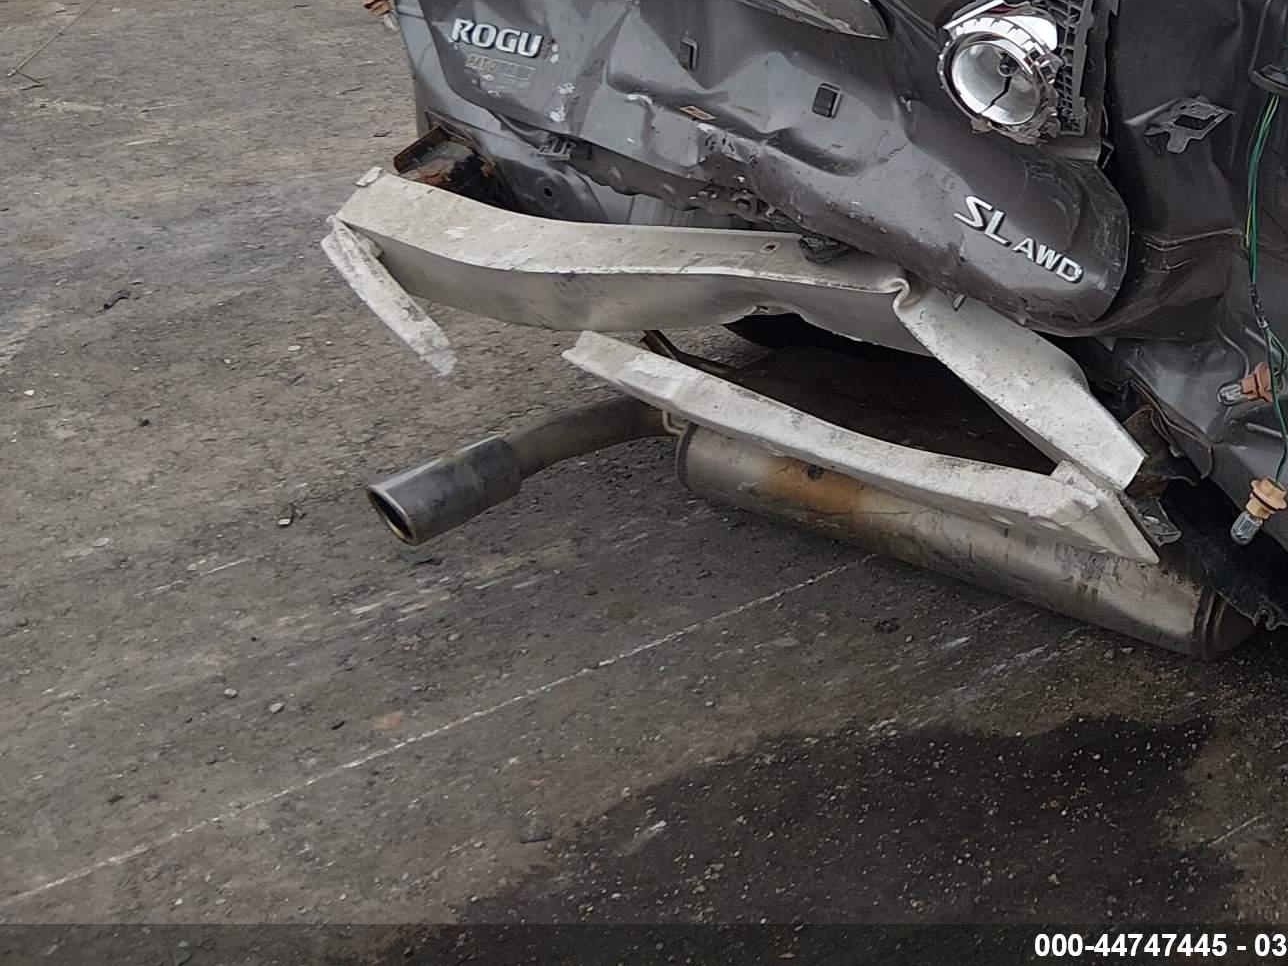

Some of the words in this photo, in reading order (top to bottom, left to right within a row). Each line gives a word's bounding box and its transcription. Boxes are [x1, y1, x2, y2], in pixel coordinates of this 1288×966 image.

[450, 17, 544, 58] ROGU
[953, 194, 1011, 247] SL
[1012, 236, 1085, 284] AWD
